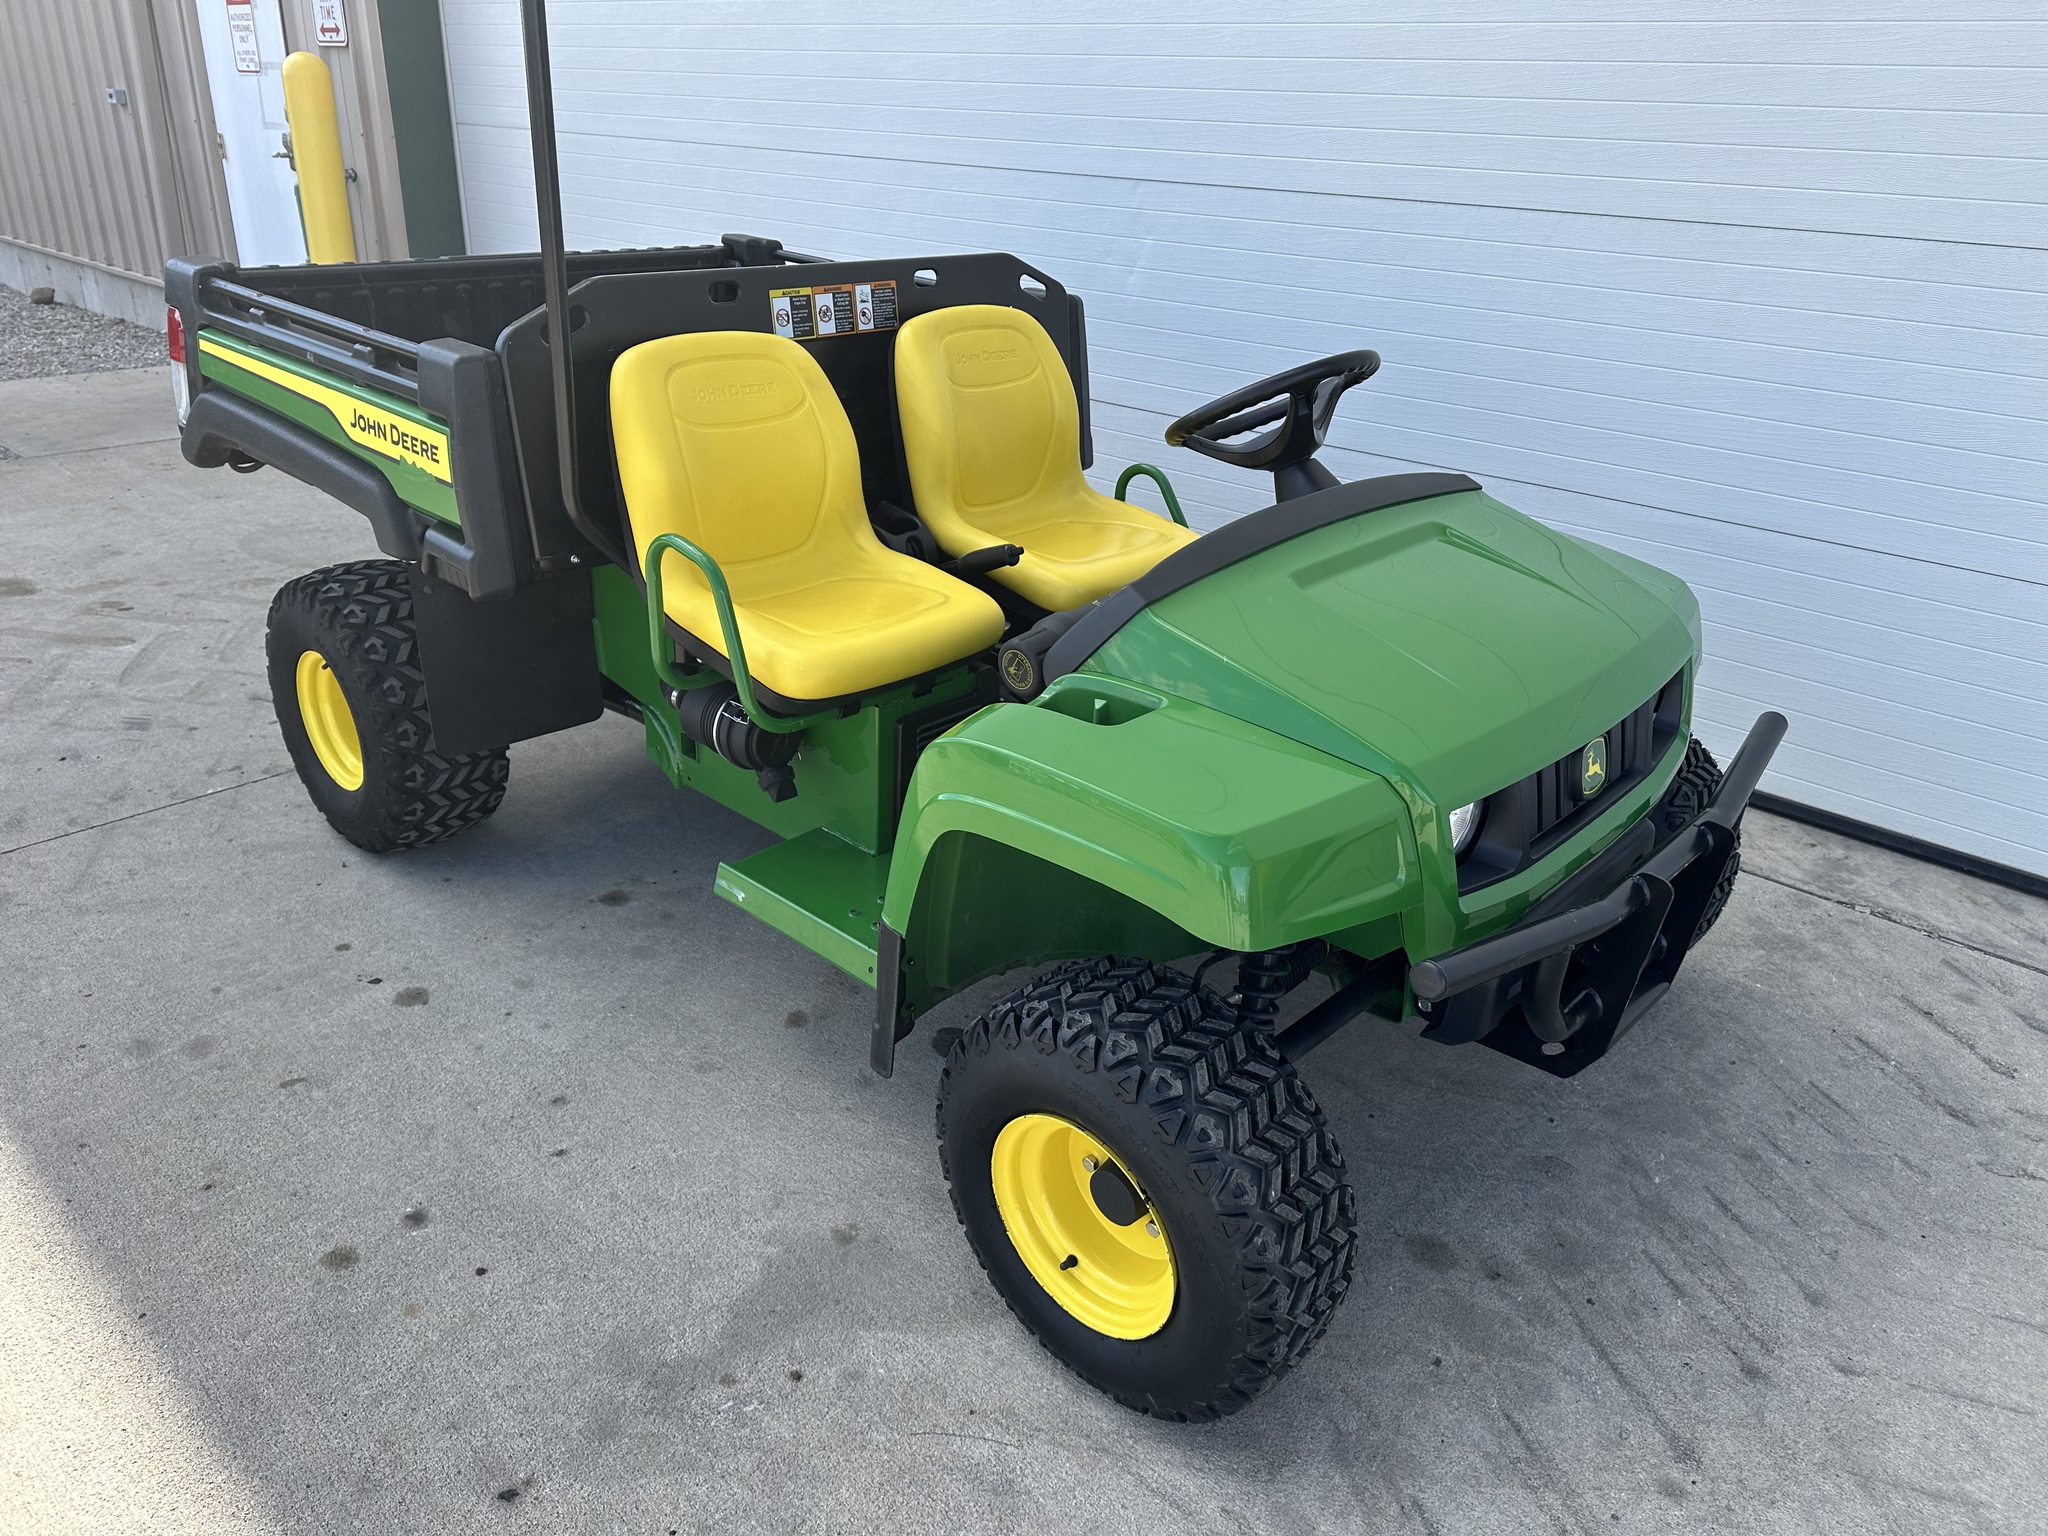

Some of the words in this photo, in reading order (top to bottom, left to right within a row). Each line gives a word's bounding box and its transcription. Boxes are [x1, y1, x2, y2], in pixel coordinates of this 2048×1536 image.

[230, 13, 252, 21] AUTHORIZED
[320, 5, 336, 20] TIME
[232, 24, 253, 33] PERSONNEL
[239, 35, 249, 43] ONLY
[956, 352, 981, 366] JOHN
[980, 349, 1018, 364] DEERE
[692, 387, 729, 403] JOHN
[728, 382, 778, 398] DEERE
[350, 408, 387, 441] JOHN
[390, 423, 440, 464] DEERE
